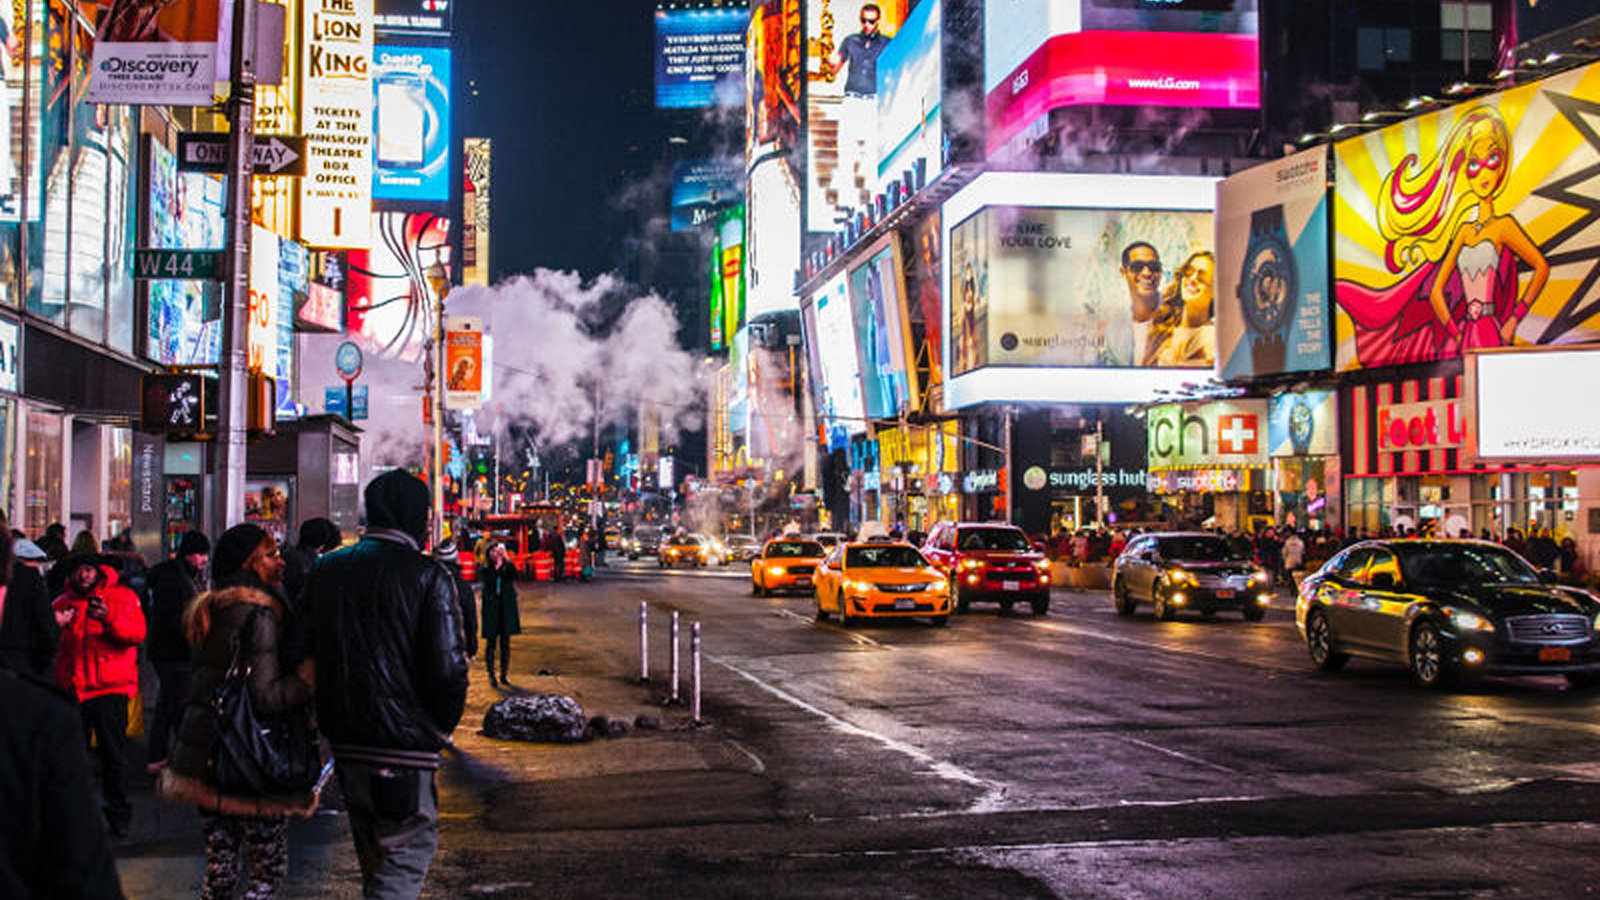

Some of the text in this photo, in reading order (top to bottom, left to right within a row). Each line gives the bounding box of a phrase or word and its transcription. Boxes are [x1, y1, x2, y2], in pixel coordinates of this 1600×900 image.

[321, 0, 354, 10] THE
[313, 13, 361, 42] LION
[310, 44, 368, 78] KING
[107, 57, 199, 78] Discovery
[313, 106, 361, 118] TICKETS
[315, 120, 357, 131] AT THE
[310, 146, 363, 158] THEATRE
[323, 161, 350, 171] BOX
[315, 173, 357, 184] OFFICE
[1038, 236, 1072, 248] LOVE
[139, 253, 162, 275] W
[165, 253, 194, 275] 44
[1378, 406, 1438, 449] Foot
[1048, 467, 1117, 490] sunglass
[1119, 468, 1146, 486] hut
